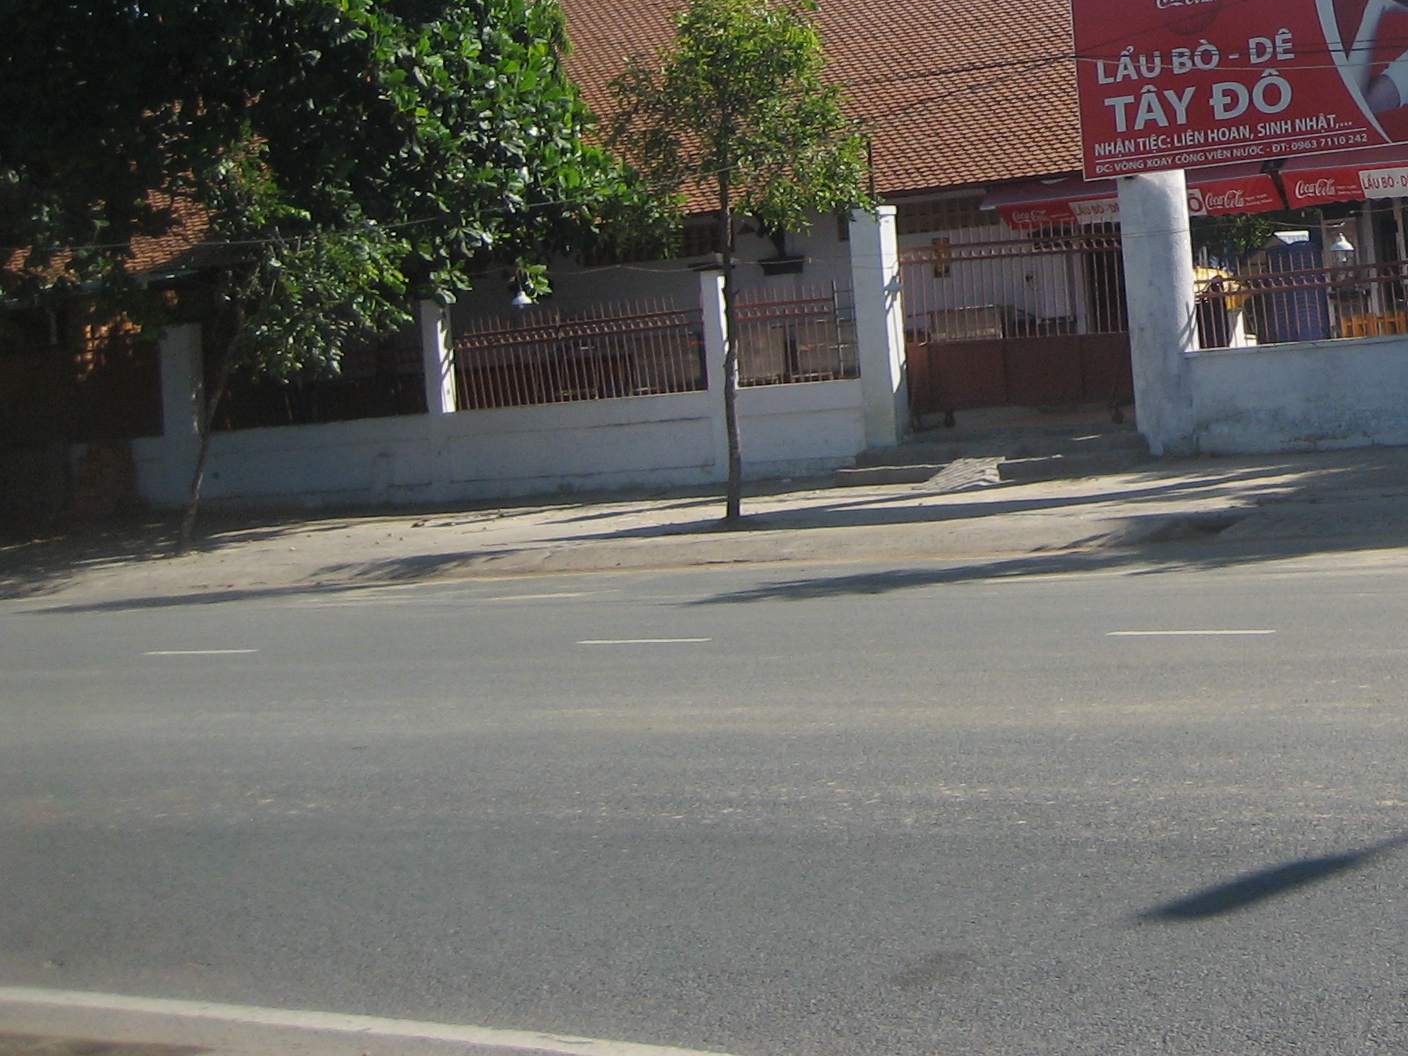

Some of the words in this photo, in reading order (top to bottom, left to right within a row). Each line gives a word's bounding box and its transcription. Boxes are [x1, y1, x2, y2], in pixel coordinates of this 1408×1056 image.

[1097, 45, 1162, 84] LẨU
[1171, 39, 1220, 74] BÒ
[1248, 28, 1295, 64] DÊ
[1104, 85, 1196, 132] TÂY
[1209, 68, 1293, 120] ĐÔ
[1095, 137, 1139, 158] NHẬN
[1139, 133, 1171, 154] TIỆC:
[1173, 129, 1204, 147] LIÊN
[1207, 125, 1254, 143] HOAN,
[1257, 120, 1292, 137] SINH
[1114, 158, 1145, 171] VÒNG
[1146, 157, 1174, 168] XOAY
[1175, 152, 1205, 165] CÔNG
[1205, 149, 1232, 161] VIÊN
[1272, 143, 1290, 153] ĐT:
[1320, 135, 1346, 147] 7110
[1348, 133, 1368, 144] 242
